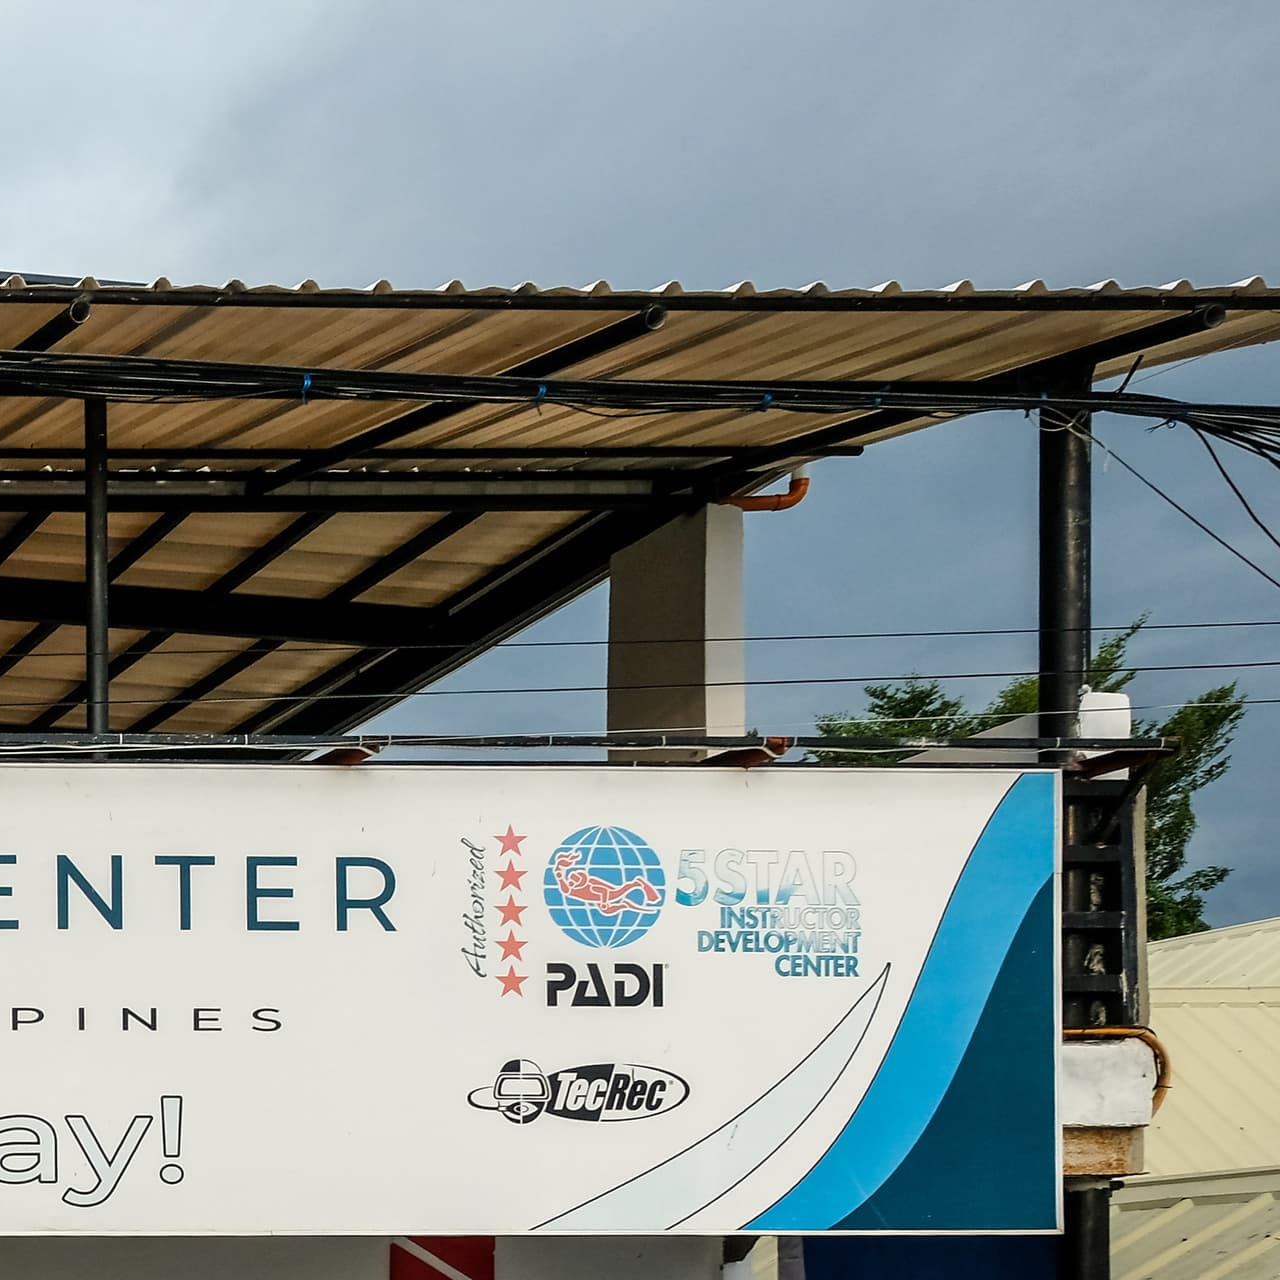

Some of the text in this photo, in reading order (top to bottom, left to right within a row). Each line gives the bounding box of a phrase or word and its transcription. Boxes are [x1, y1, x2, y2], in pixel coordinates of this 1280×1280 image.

[676, 849, 861, 907] 5 STAR
[460, 838, 487, 978] Authorized
[720, 906, 862, 931] INSTRUCTOR
[697, 930, 862, 953] DEVELOPMENT
[547, 962, 665, 1007] PADI
[776, 955, 860, 977] CENTER
[553, 1069, 668, 1113] TecRec
